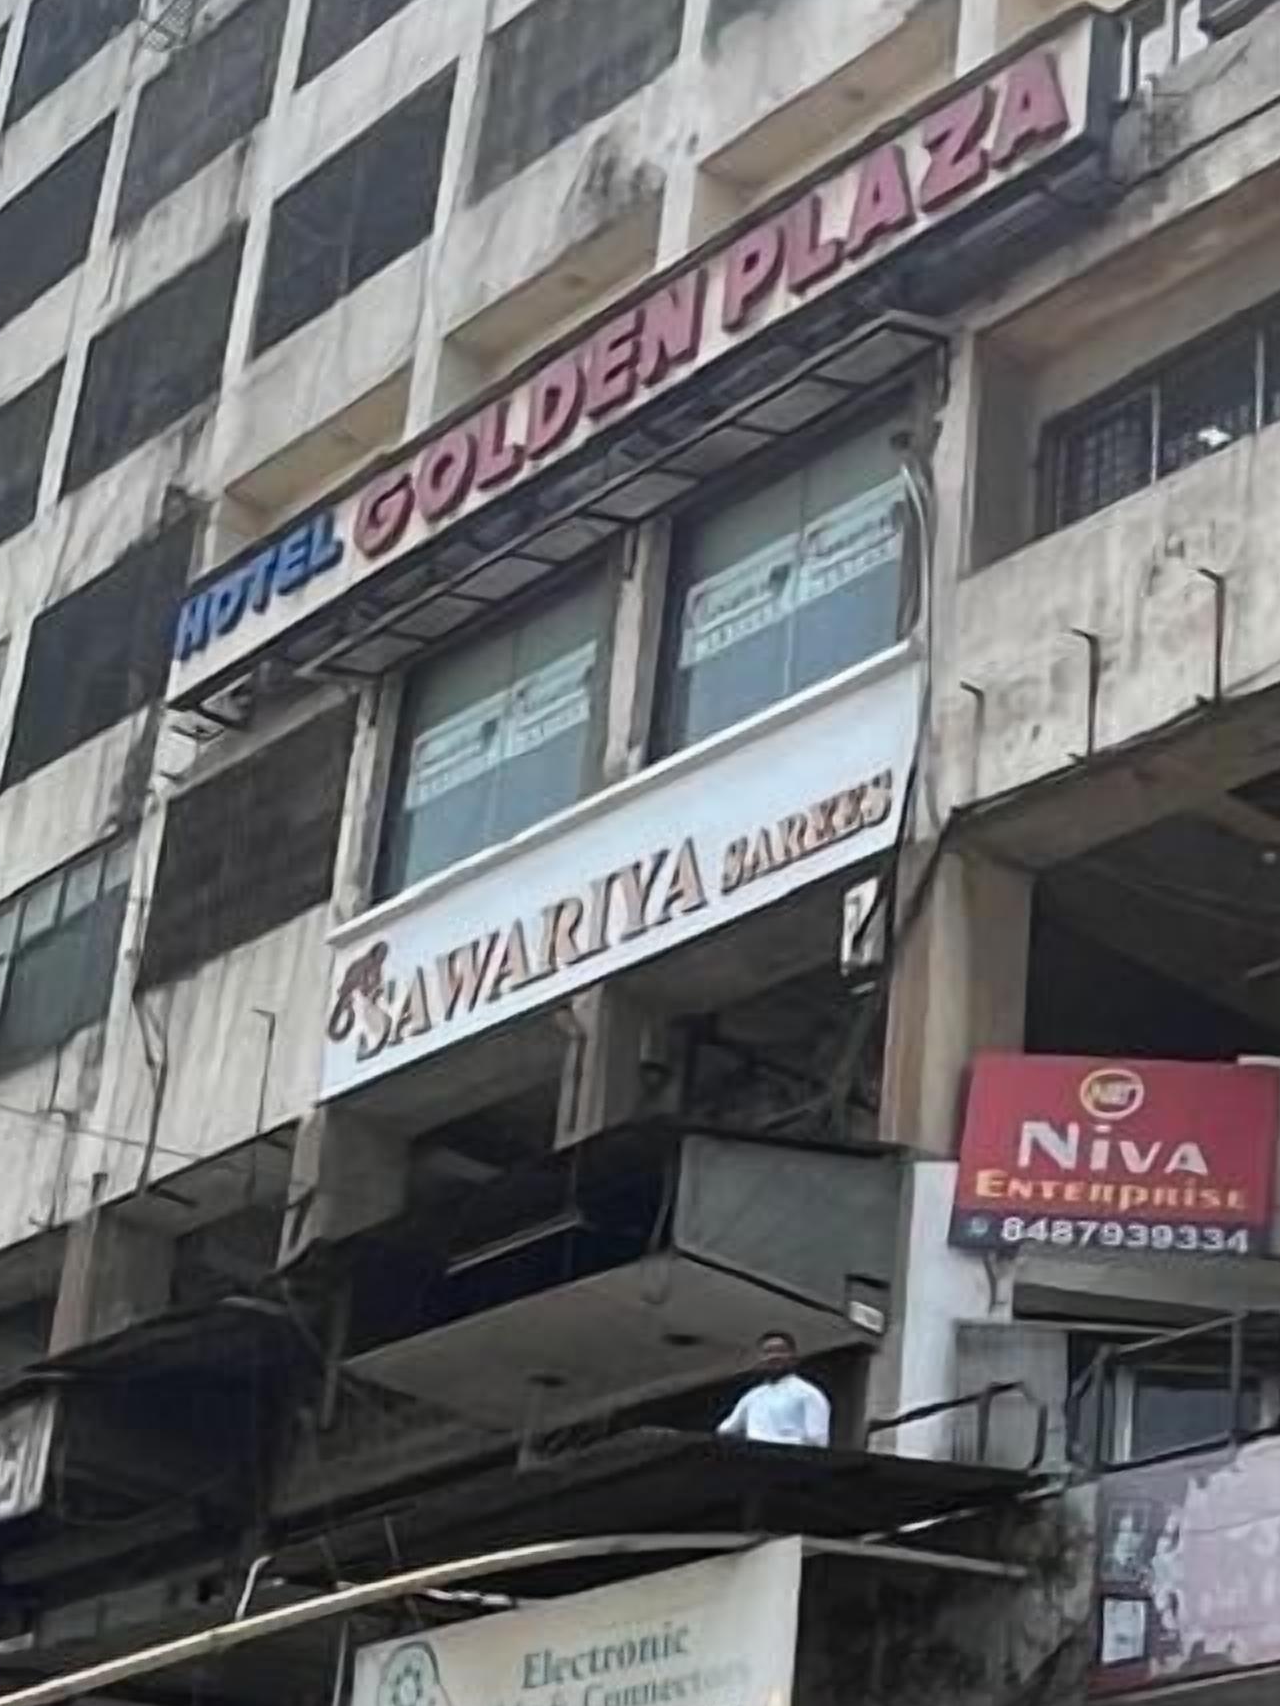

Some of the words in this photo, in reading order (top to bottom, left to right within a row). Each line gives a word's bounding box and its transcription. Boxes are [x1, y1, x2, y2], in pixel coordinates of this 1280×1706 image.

[175, 508, 344, 661] HOTEL
[351, 265, 709, 558] GOLDEN
[723, 51, 1070, 333] PLAZA
[354, 837, 709, 1062] SAWARIYA
[521, 1621, 691, 1690] Electronic
